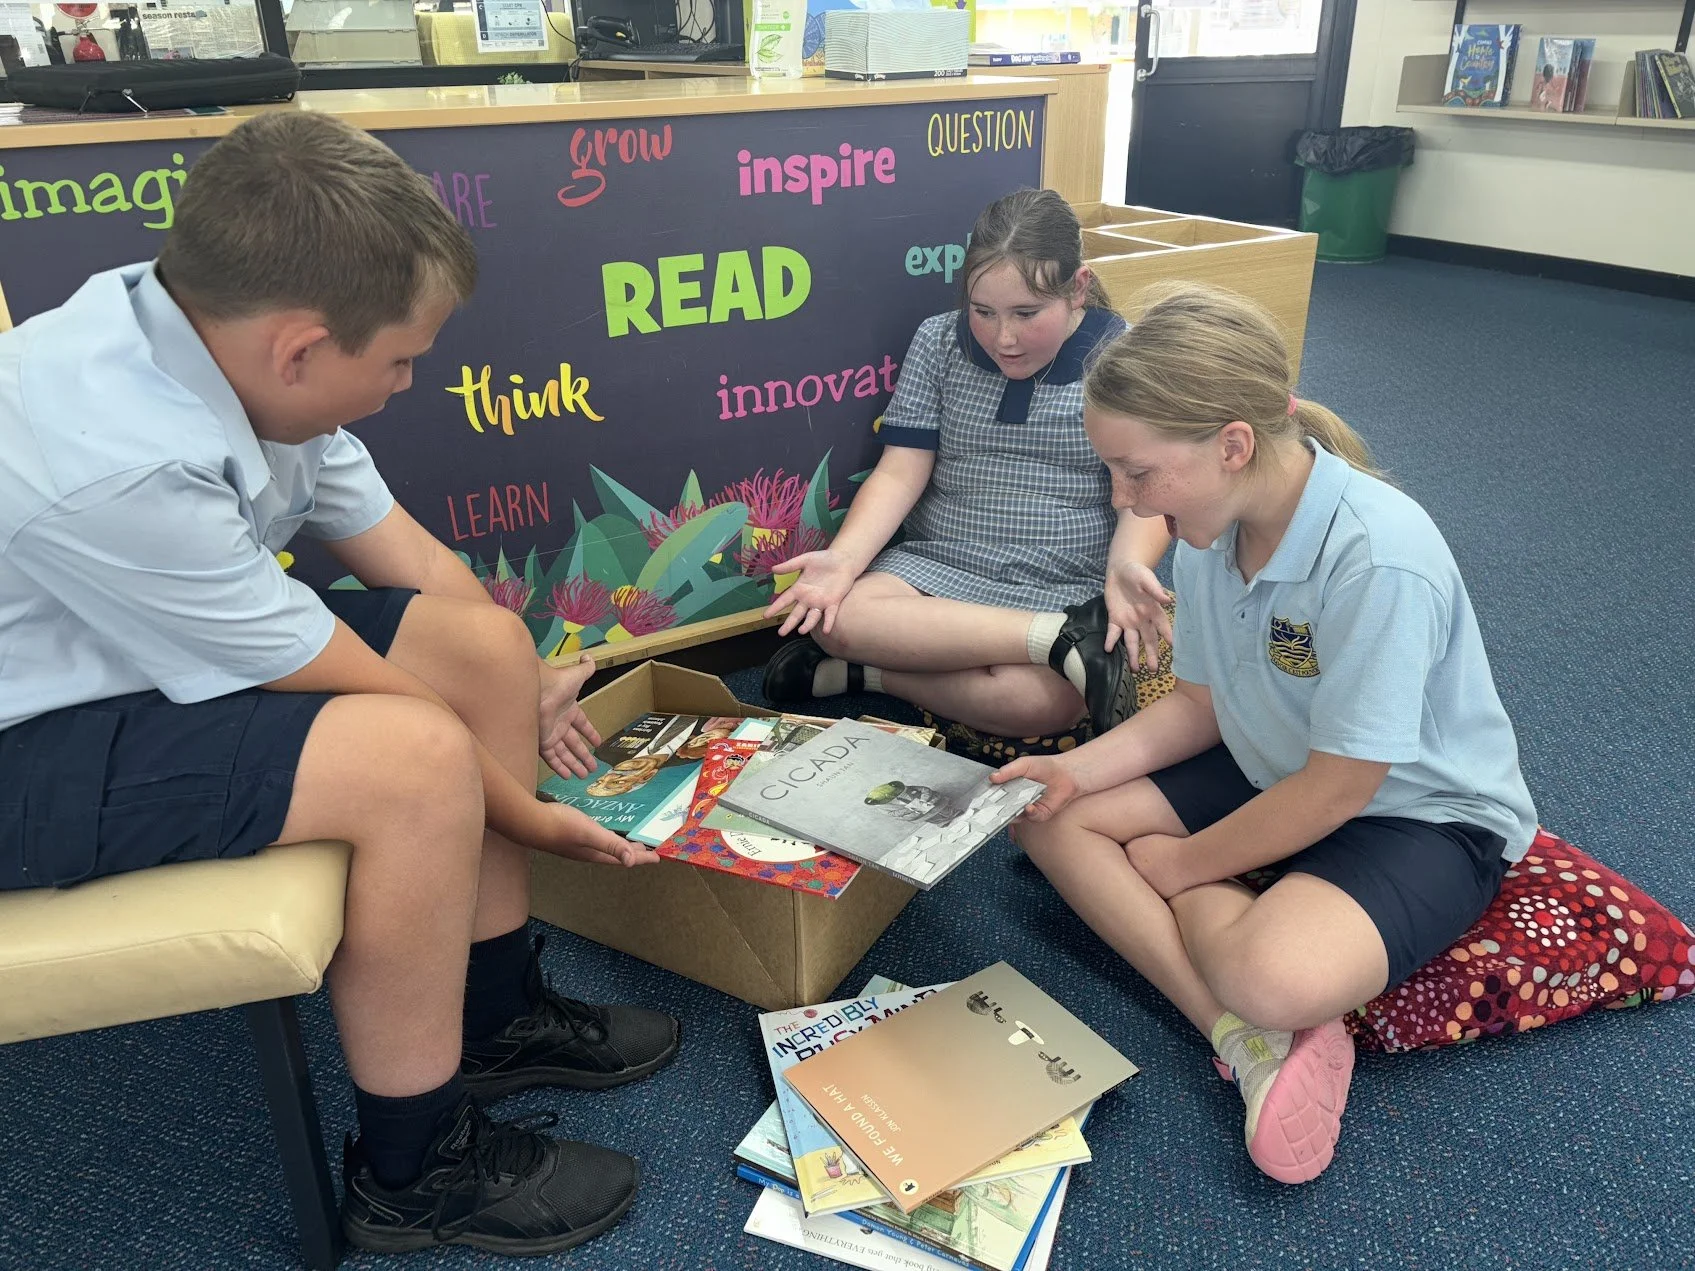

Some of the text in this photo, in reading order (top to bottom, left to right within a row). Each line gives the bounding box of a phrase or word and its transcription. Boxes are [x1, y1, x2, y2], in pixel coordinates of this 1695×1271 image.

[142, 10, 197, 20] season resta
[927, 109, 1035, 157] QUESTION
[557, 123, 672, 207] grow
[737, 143, 896, 205] inspire
[601, 245, 812, 338] READ
[445, 362, 605, 436] think
[715, 354, 898, 420] innovat
[447, 481, 550, 543] LEARN
[760, 736, 871, 801] CICADA
[816, 761, 855, 789] SHAUN TAN
[576, 797, 645, 814] ANZAC
[614, 814, 635, 823] My
[748, 811, 770, 825] CICADA
[736, 837, 763, 857] Ernie
[771, 996, 879, 1059] INCREDIBLY
[773, 1021, 801, 1035] THE
[822, 1083, 904, 1167] WE FOUND A HAT
[860, 1093, 902, 1133] JON KLASSEN
[758, 1178, 770, 1187] My
[772, 1183, 785, 1194] Pop
[801, 1229, 866, 1254] EVERYTHING
[861, 1219, 885, 1233] Damon
[886, 1230, 908, 1243] Young
[916, 1240, 936, 1253] Peter
[866, 1247, 884, 1258] gets
[884, 1253, 902, 1265] that
[902, 1257, 926, 1270] book
